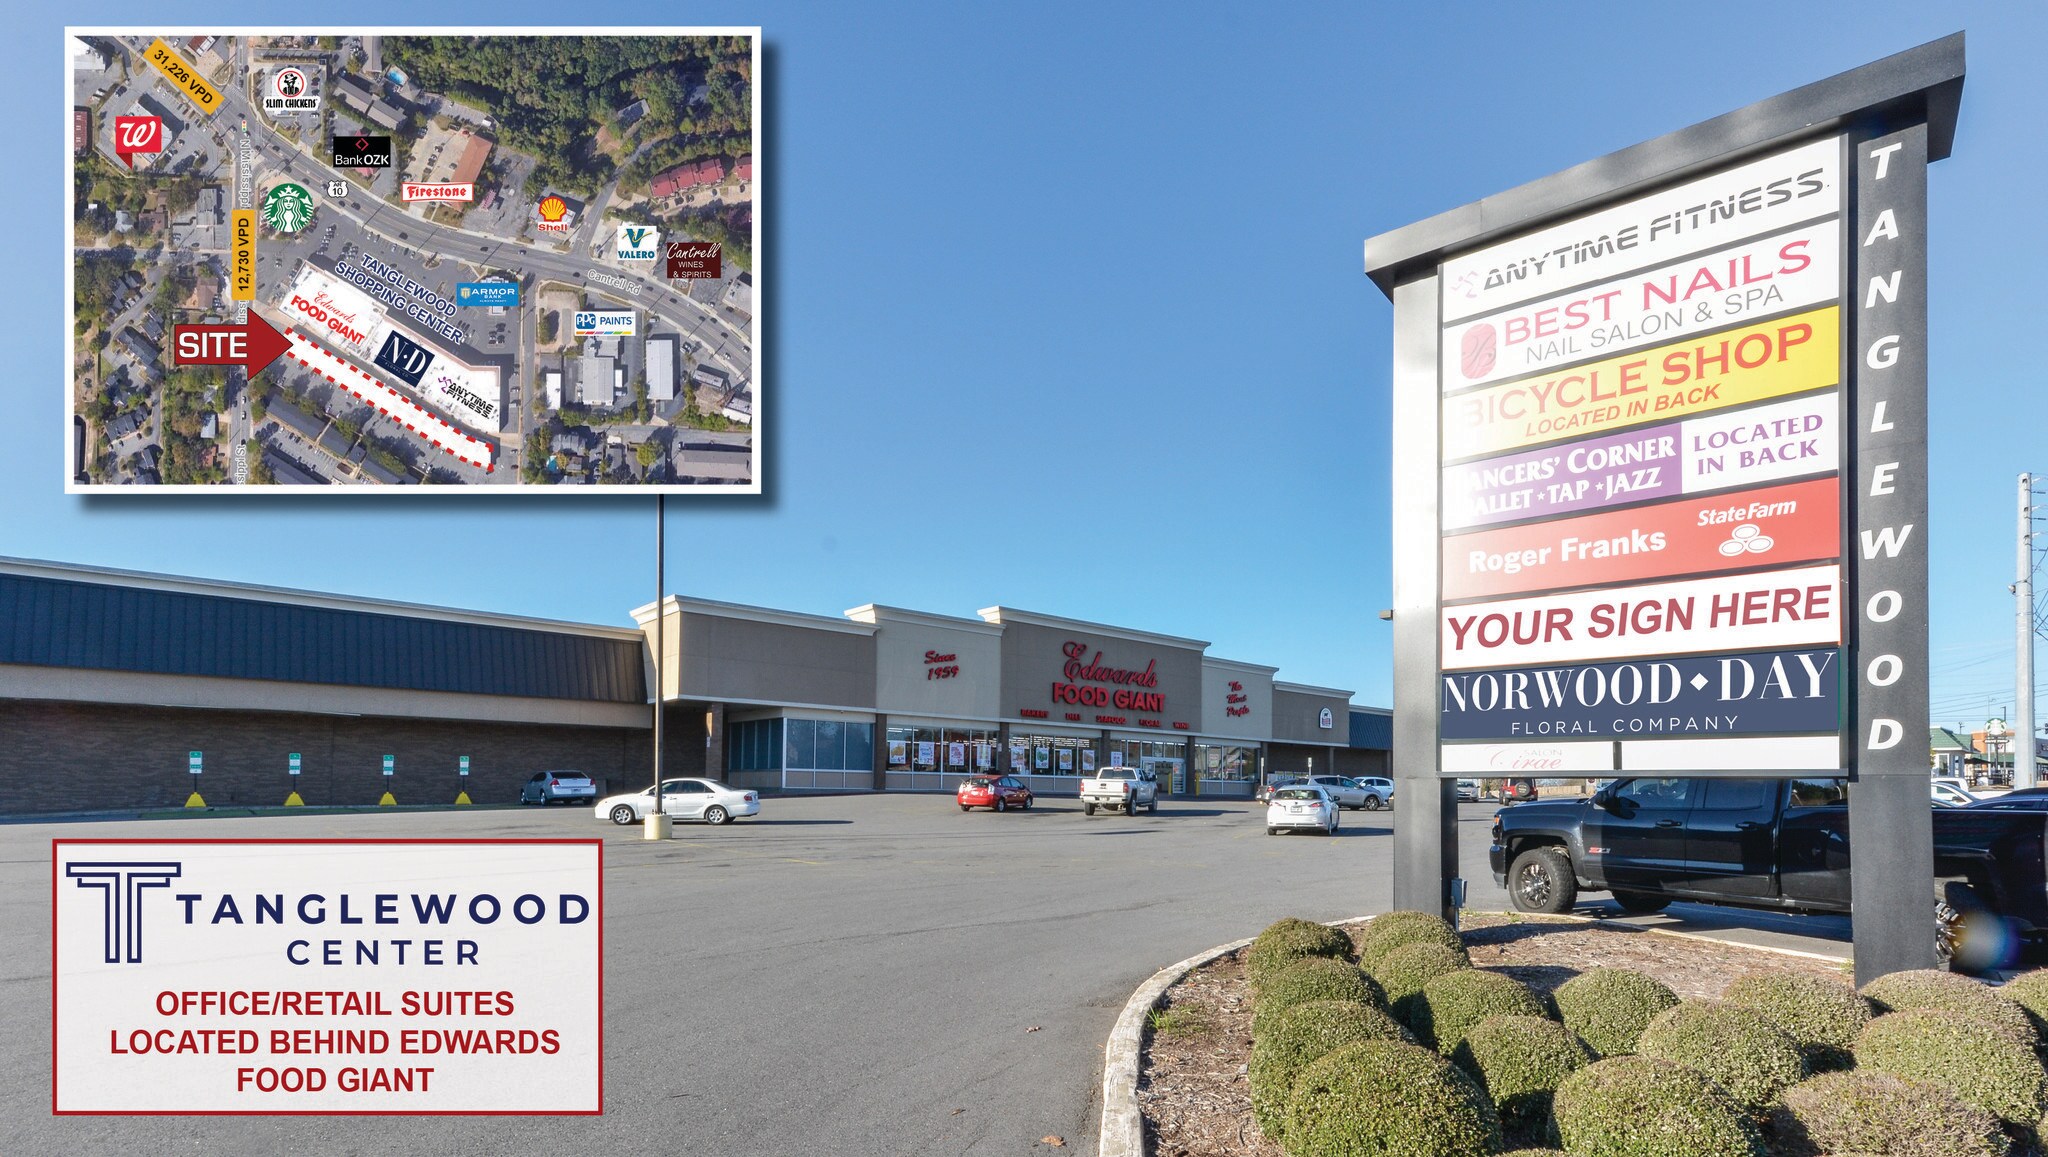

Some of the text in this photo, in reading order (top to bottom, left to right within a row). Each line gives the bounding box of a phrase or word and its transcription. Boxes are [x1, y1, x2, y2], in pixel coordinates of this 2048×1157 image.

[1483, 167, 1824, 291] ANYTIME FITNESS
[1504, 239, 1812, 347] BEST NAILS
[1526, 329, 1582, 365] NAIL
[1590, 305, 1684, 349] SALON
[1694, 301, 1714, 323] &
[1725, 283, 1784, 312] SPA
[1462, 322, 1813, 427] BICYCLE SHOP
[1525, 383, 1721, 438] LOCATED IN BACK
[1694, 413, 1823, 452] LOCATED
[1465, 435, 1676, 492] ANCERS' CORNER
[1697, 437, 1820, 475] IN BACK
[1861, 142, 1913, 752] TANGLEWOOD
[1470, 467, 1663, 516] ALLET TAP JAZZ
[1469, 528, 1667, 576] Roger Franks
[1447, 584, 1832, 651] YOUR SIGN HERE
[928, 665, 959, 680] 1959
[1063, 640, 1158, 688] Edwards
[1441, 651, 1837, 713] NORWOOD DAY
[1052, 682, 1165, 712] FOOD GIANT
[1511, 715, 1739, 735] FLORAL COMPANY
